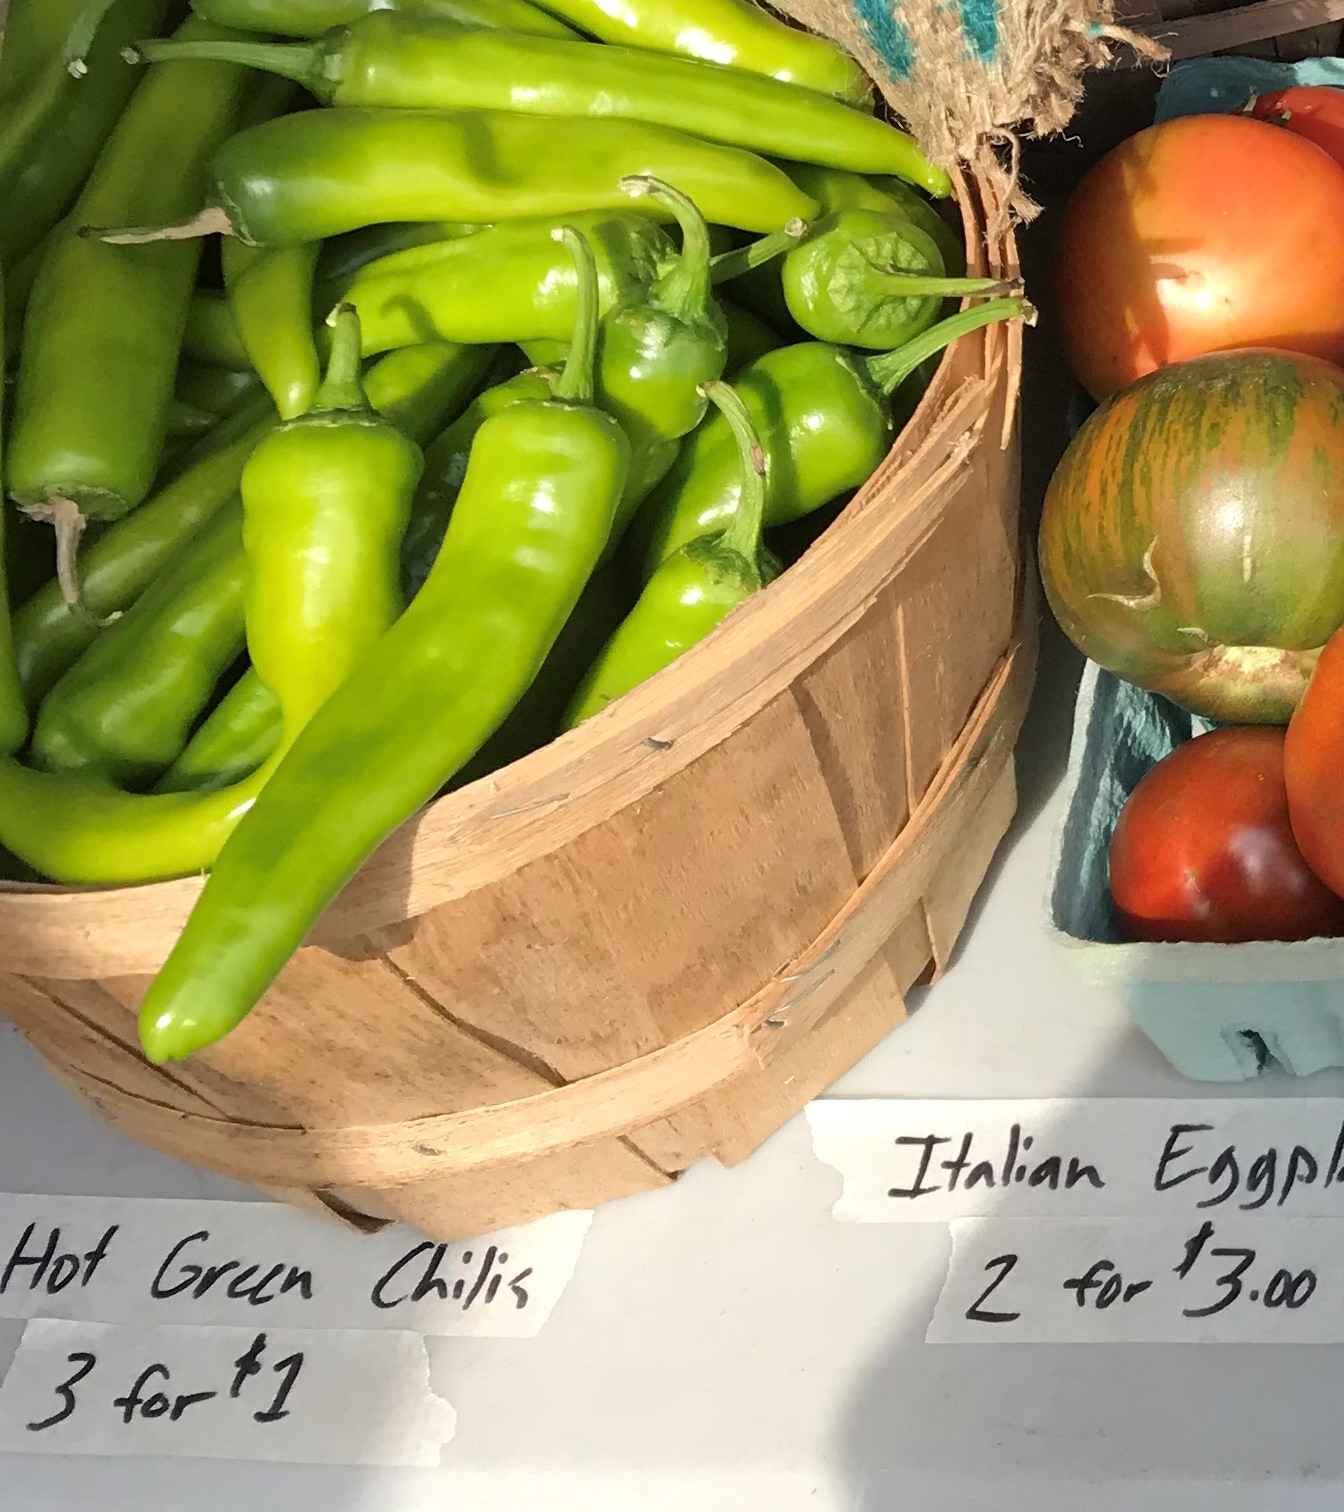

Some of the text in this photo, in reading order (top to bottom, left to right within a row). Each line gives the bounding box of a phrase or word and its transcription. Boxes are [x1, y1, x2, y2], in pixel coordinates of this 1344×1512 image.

[888, 1123, 1105, 1198] Italian
[0, 1223, 533, 1309] Hot Green Chilis
[965, 1221, 1317, 1322] 2 for $3.00
[26, 1352, 96, 1430] 3
[114, 1364, 216, 1423] for
